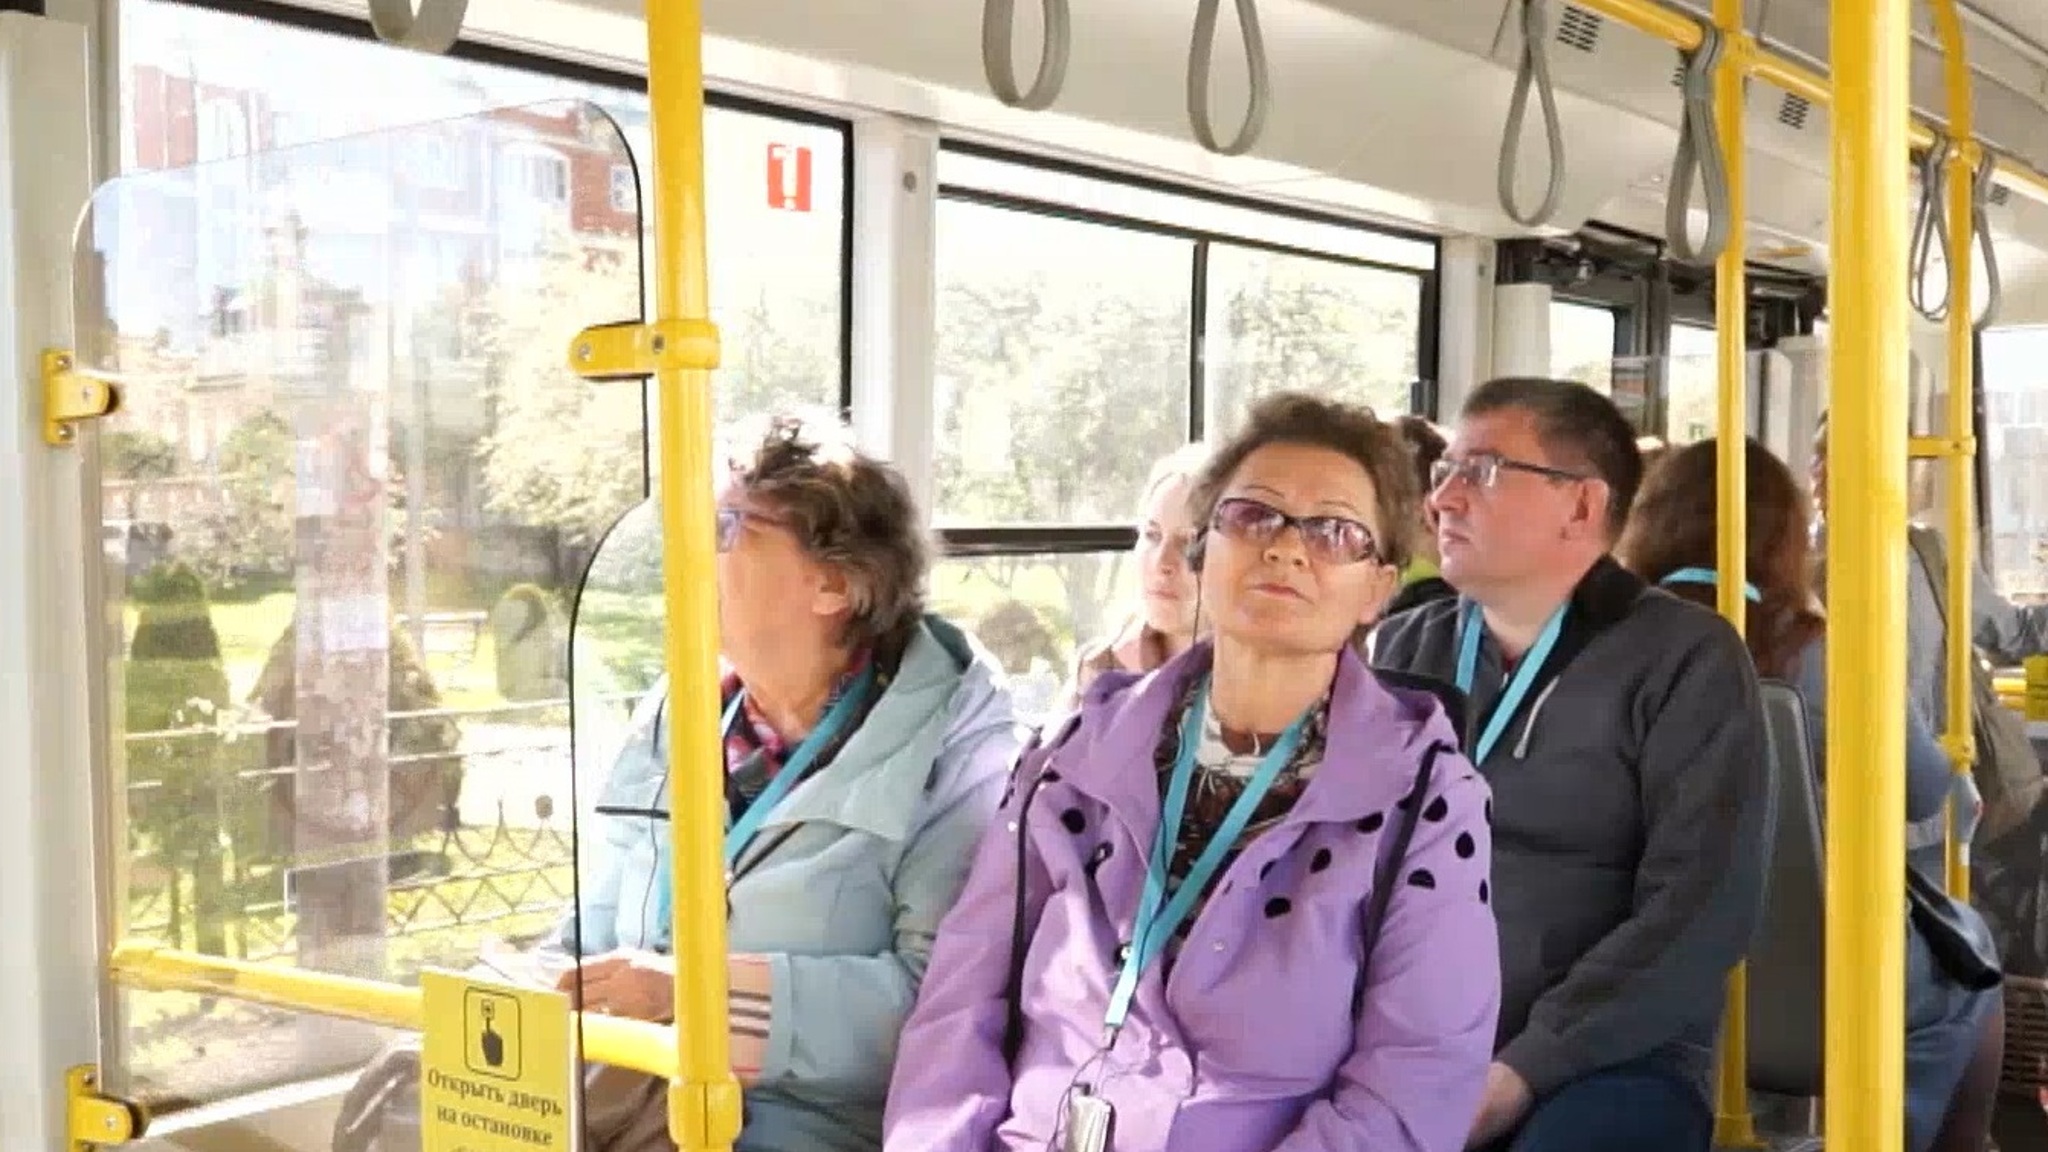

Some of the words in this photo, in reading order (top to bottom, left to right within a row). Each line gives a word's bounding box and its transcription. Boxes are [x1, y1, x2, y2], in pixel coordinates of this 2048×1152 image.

[428, 1068, 504, 1103] Открыть
[508, 1090, 563, 1117] дверь
[437, 1105, 457, 1125] на
[461, 1112, 552, 1146] остановке
